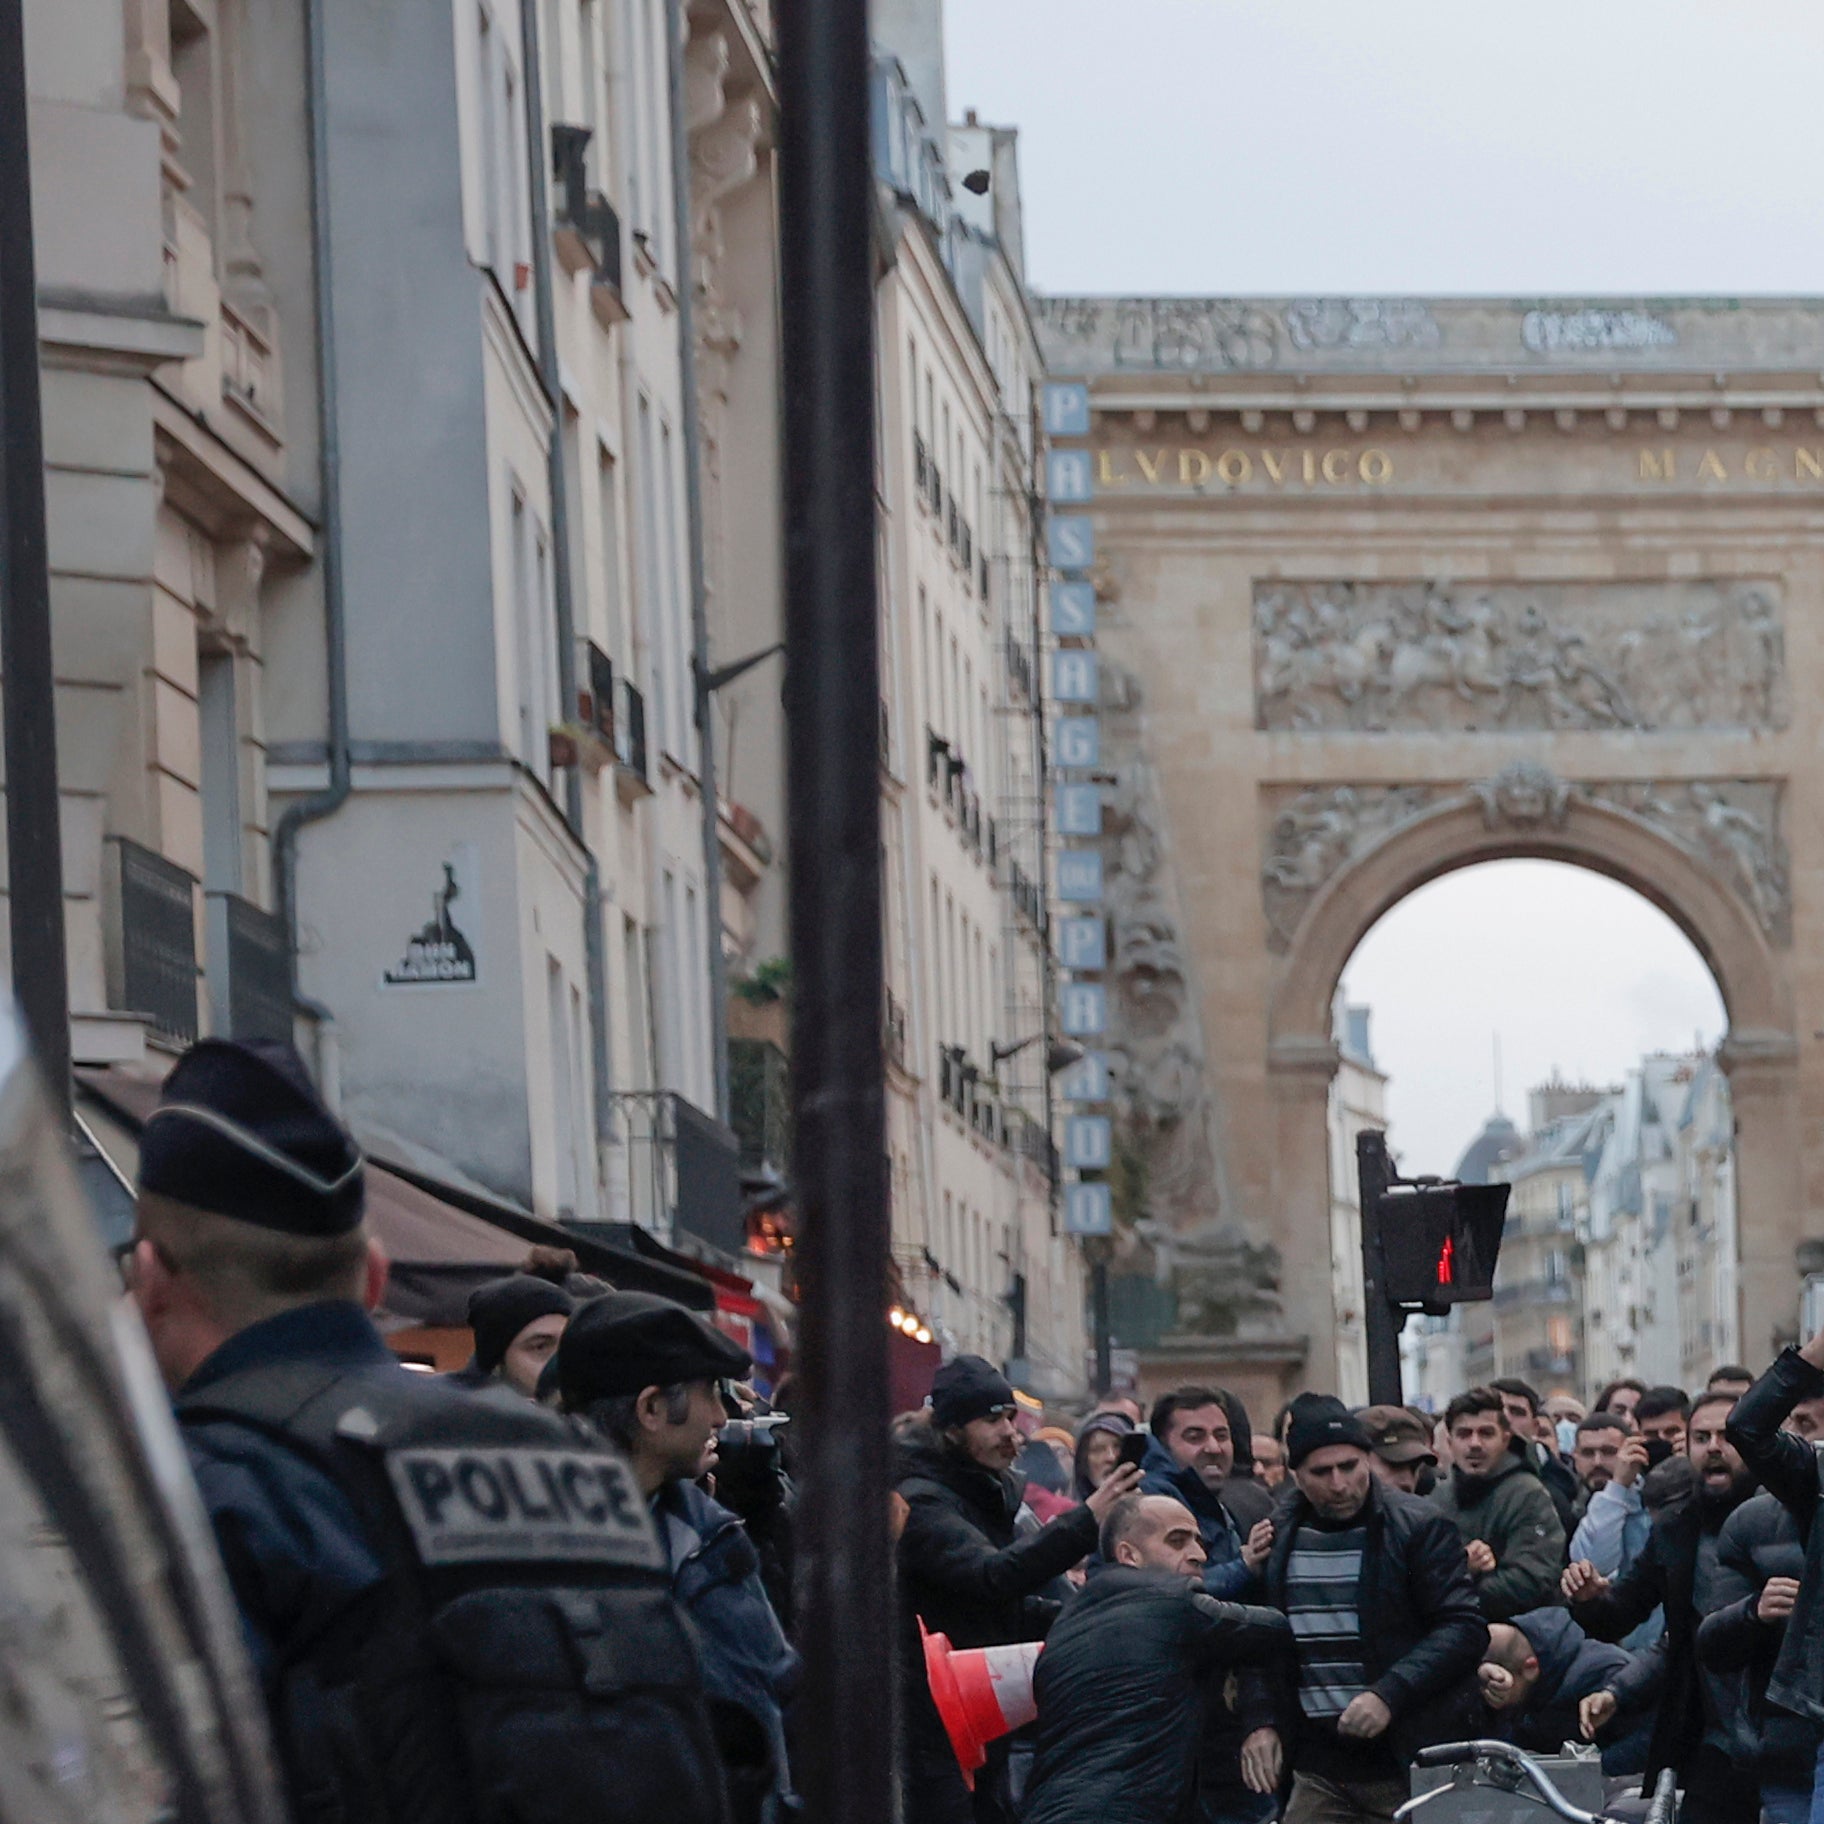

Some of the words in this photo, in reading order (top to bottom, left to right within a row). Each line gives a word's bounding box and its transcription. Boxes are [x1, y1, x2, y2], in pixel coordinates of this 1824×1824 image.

[1099, 447, 1394, 487] LVDOVICO
[1049, 384, 1092, 832] PASSAGE
[402, 1455, 642, 1528] POLICE
